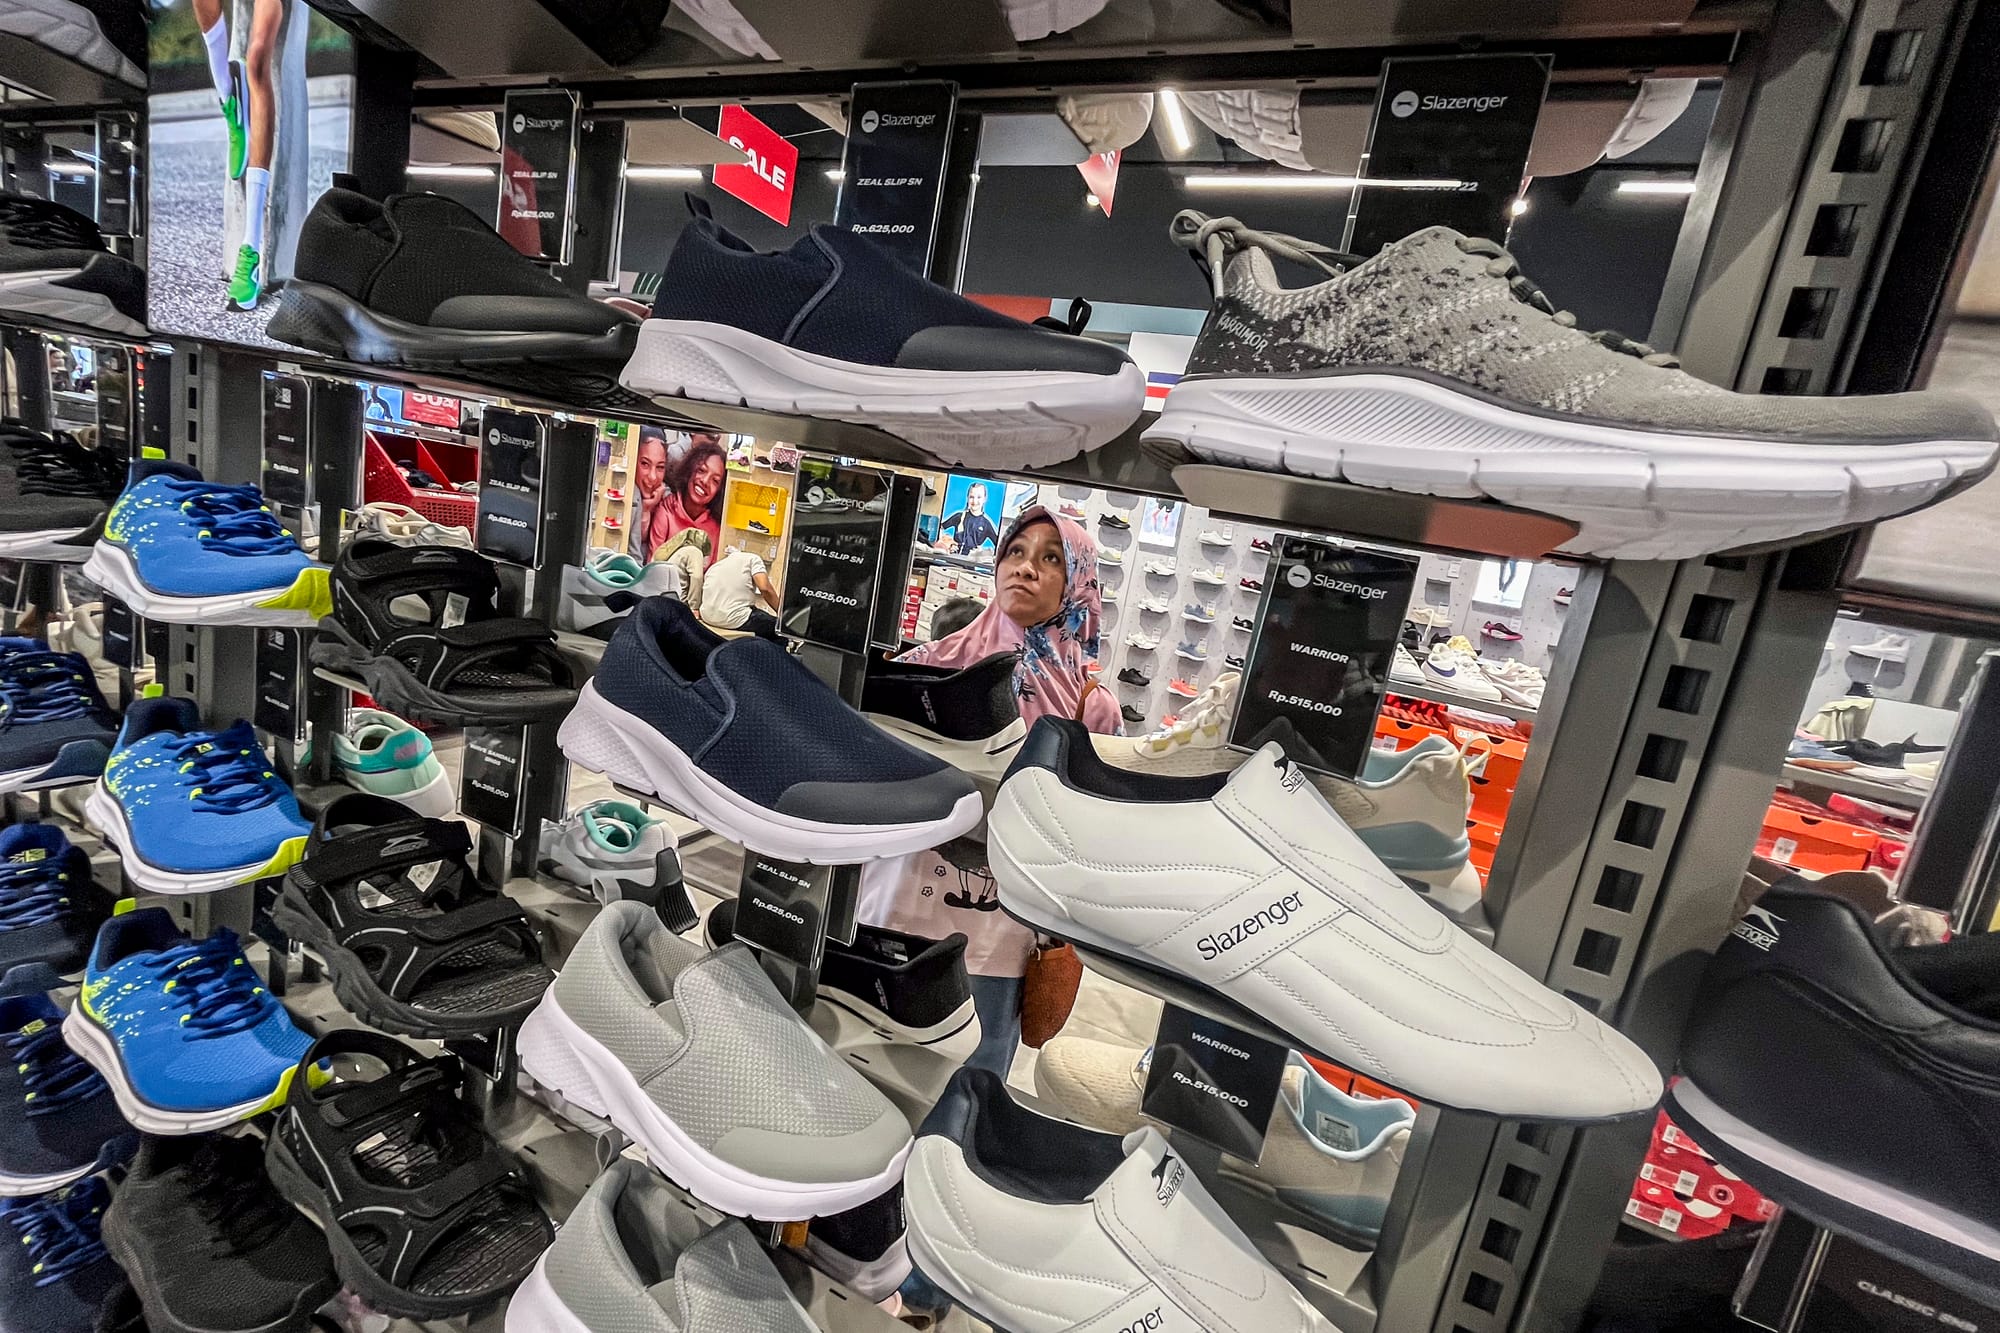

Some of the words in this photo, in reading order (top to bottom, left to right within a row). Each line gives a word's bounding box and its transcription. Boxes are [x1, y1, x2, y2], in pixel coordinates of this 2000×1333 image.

[1421, 95, 1508, 112] Slazenger
[526, 117, 564, 130] Slazenger
[880, 113, 936, 127] Slazenger
[857, 178, 883, 186] ZEAL
[884, 177, 907, 186] SLIP
[907, 177, 923, 186] SN
[852, 224, 915, 234] Rp.625,000
[501, 432, 536, 449] Slazenger
[804, 545, 828, 557] ZEAL
[828, 551, 850, 562] SLIP
[850, 555, 865, 565] SN
[799, 586, 858, 607] Rp.625,000
[1312, 573, 1388, 600] Slazenger
[1290, 642, 1350, 664] WARRIOR
[1267, 689, 1343, 717] Rp.515,000
[756, 861, 778, 875] ZEAL
[778, 871, 799, 882] SLIP
[797, 879, 812, 889] SN
[752, 897, 805, 925] Rp.625,000
[1196, 890, 1304, 961] Slazenger
[1191, 1031, 1251, 1060] WARRIOR
[1172, 1071, 1249, 1108] Rp.515,000
